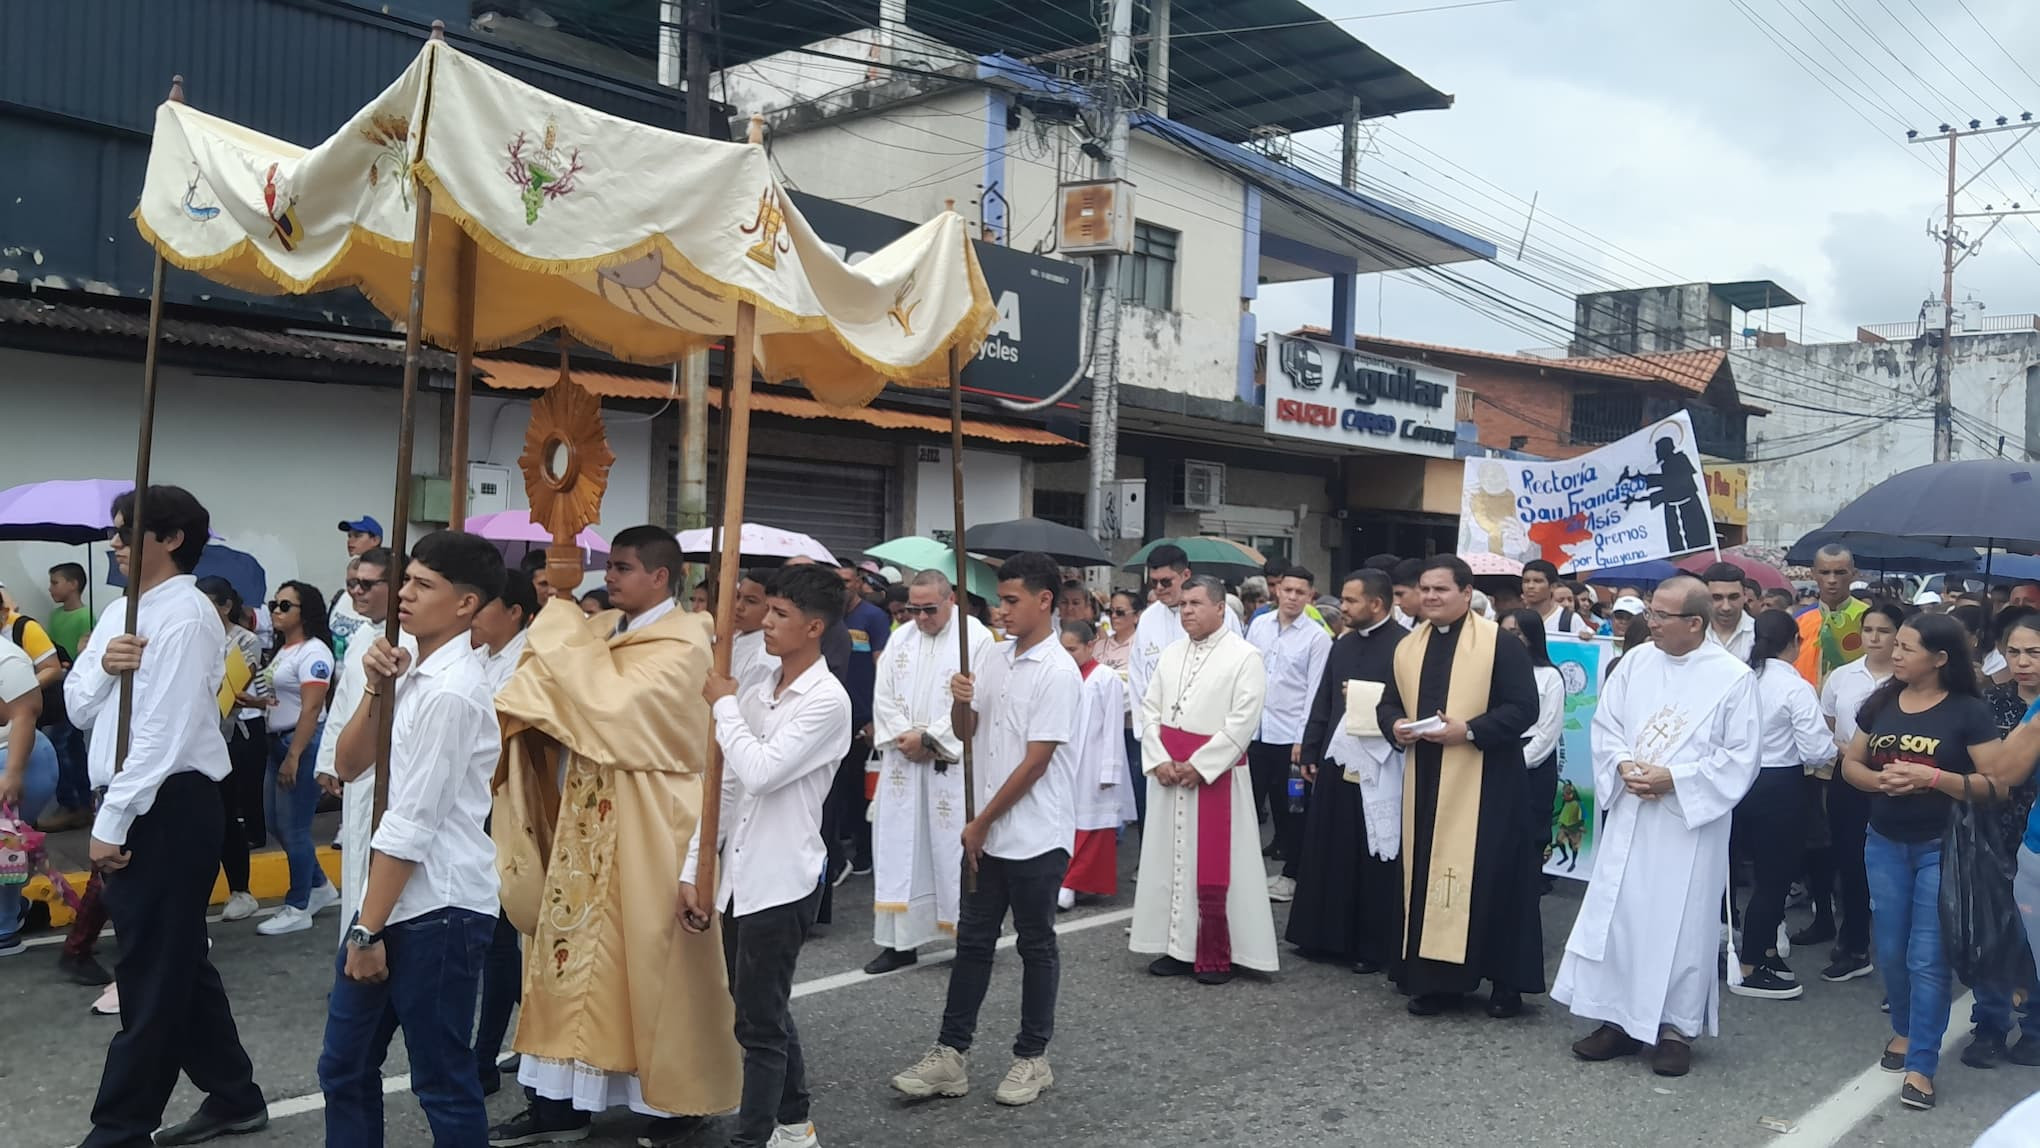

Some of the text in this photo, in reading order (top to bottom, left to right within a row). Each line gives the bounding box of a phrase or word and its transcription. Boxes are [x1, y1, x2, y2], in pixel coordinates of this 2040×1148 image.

[1331, 351, 1449, 409] Aguilar
[1277, 398, 1337, 428] ISUZU
[1521, 462, 1598, 495] Rectoría
[1517, 477, 1648, 523] San Francisco
[1571, 547, 1648, 574] por Guayana
[1899, 734, 1940, 755] SOY
